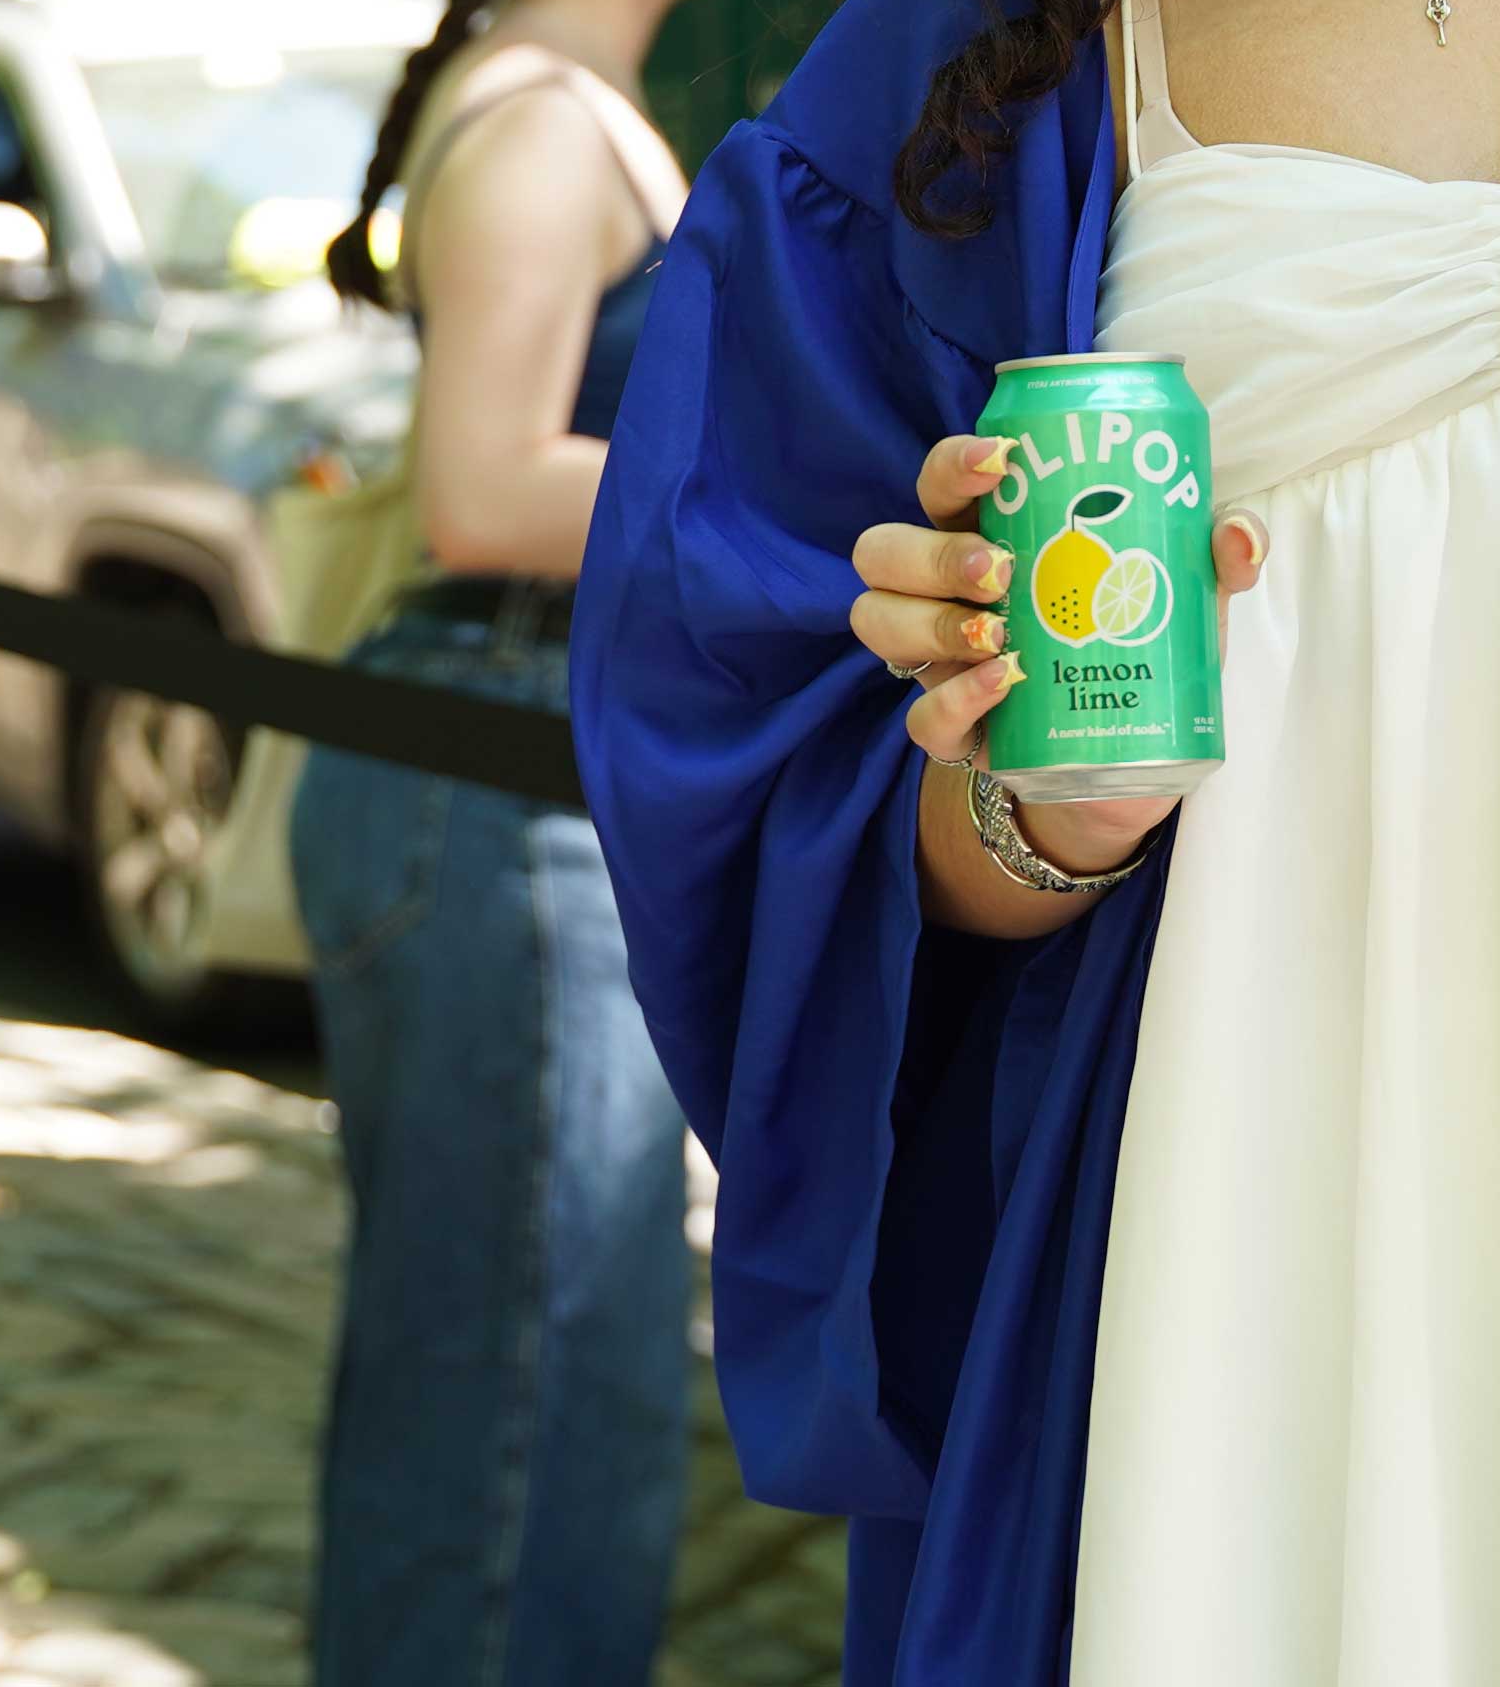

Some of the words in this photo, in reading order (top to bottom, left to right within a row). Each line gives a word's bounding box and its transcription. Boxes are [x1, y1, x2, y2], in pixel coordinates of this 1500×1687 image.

[993, 411, 1200, 515] OLIPOP
[1052, 659, 1153, 684] lemon
[1068, 686, 1140, 711] lime
[1047, 727, 1058, 739] A
[1086, 725, 1116, 737] kind
[1117, 723, 1132, 736] of
